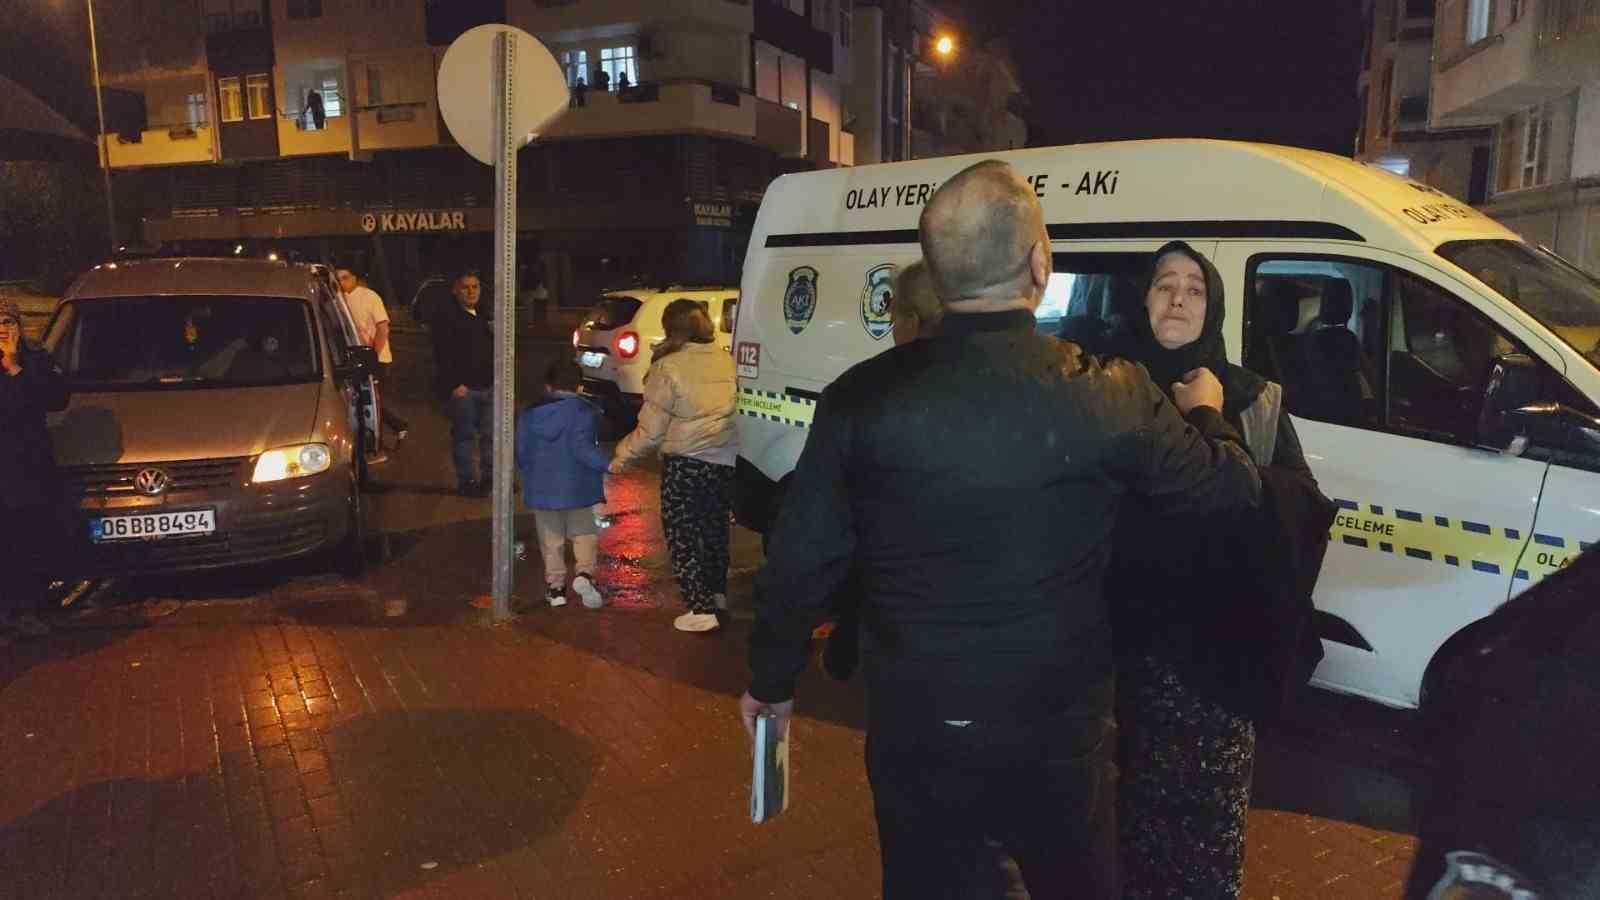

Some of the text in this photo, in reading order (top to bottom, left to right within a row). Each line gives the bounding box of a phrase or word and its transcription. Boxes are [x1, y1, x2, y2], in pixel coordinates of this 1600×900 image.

[846, 186, 891, 209] OLAY
[382, 211, 465, 231] KAYALAR
[740, 345, 757, 364] 112
[1336, 515, 1394, 536] CELEME
[1537, 552, 1569, 568] OLA
